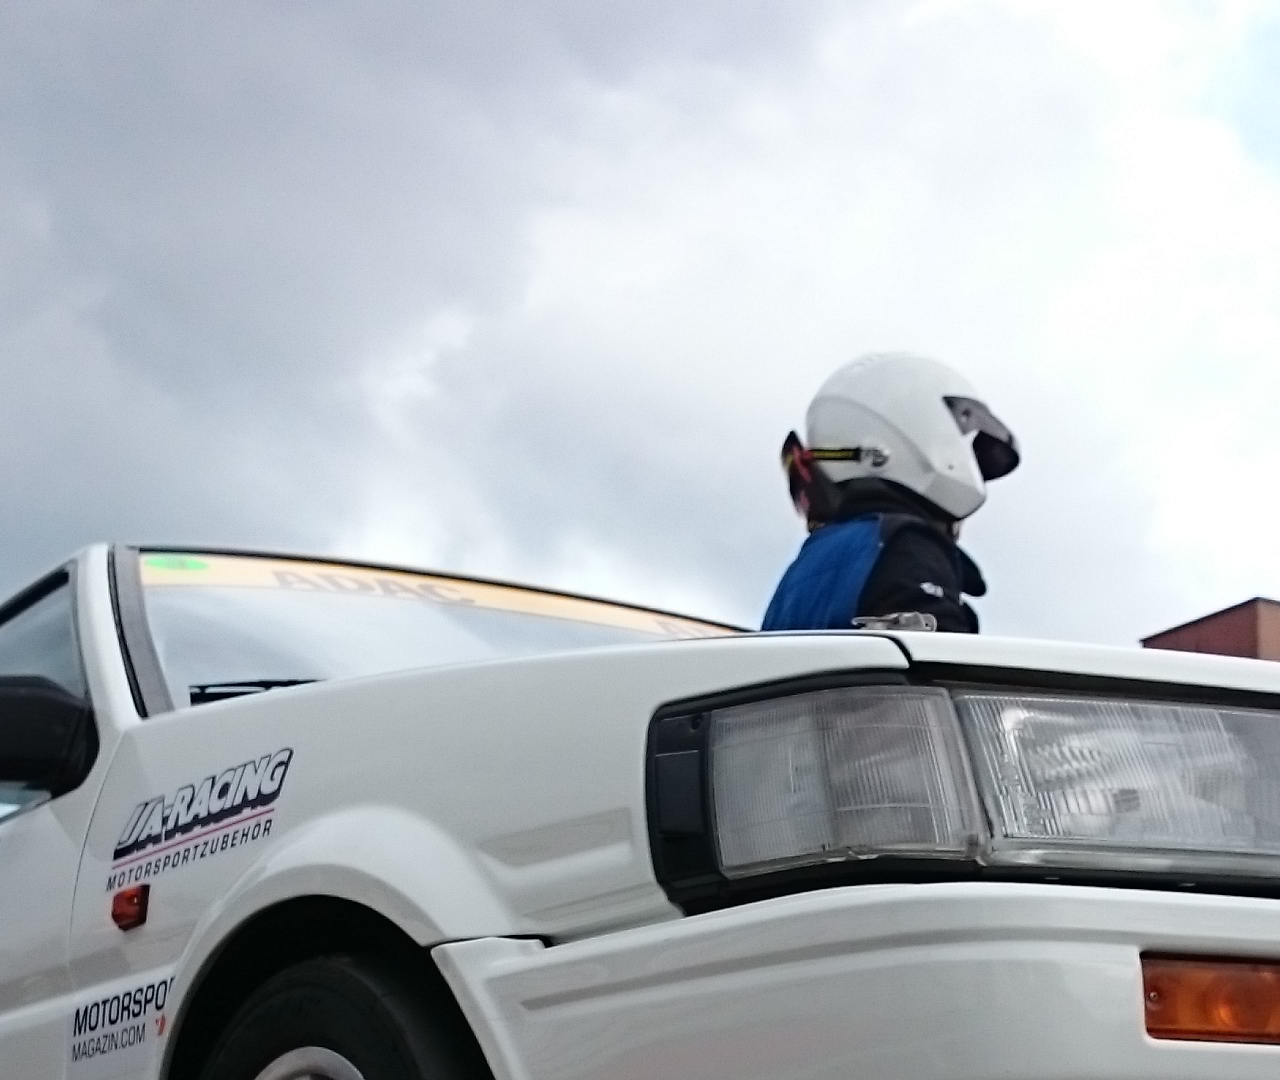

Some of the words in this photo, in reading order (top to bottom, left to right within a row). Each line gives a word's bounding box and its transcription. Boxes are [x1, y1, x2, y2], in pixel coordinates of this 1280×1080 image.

[271, 571, 475, 607] ADAC
[106, 818, 273, 891] MOTORSPORTZUBEHÖR
[72, 1022, 146, 1061] MAGAZIN.COM
